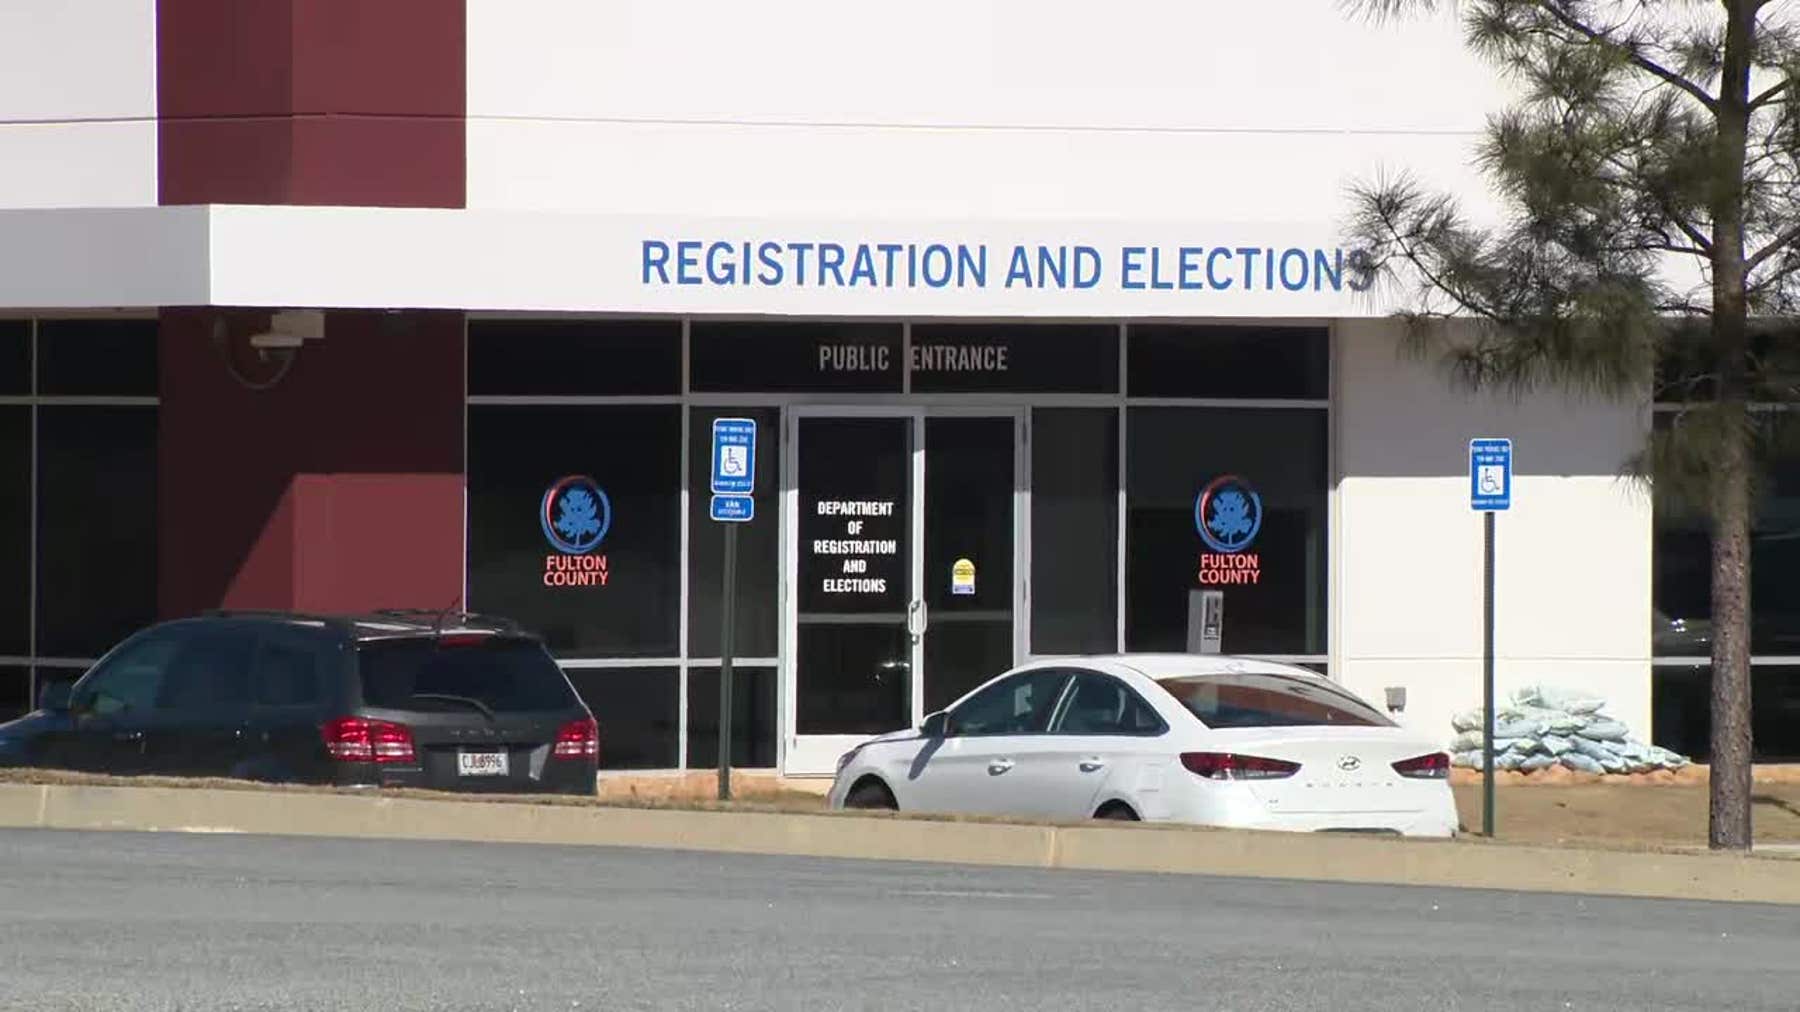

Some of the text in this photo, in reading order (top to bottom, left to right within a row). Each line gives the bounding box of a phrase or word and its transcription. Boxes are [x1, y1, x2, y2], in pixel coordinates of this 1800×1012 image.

[641, 240, 1374, 292] REGISTRATION AND ELECTIONS
[819, 346, 1008, 371] PUBLIC ENTRANCE
[817, 500, 894, 516] DEPARTMENT
[847, 520, 864, 536] OF
[813, 539, 897, 555] REGISTRATION
[546, 555, 606, 570] FULTON
[842, 559, 867, 574] AND
[1201, 554, 1258, 569] FULTON
[543, 571, 608, 586] COUNTY
[1198, 569, 1260, 584] COUNTY
[823, 578, 887, 593] ELECTIONS
